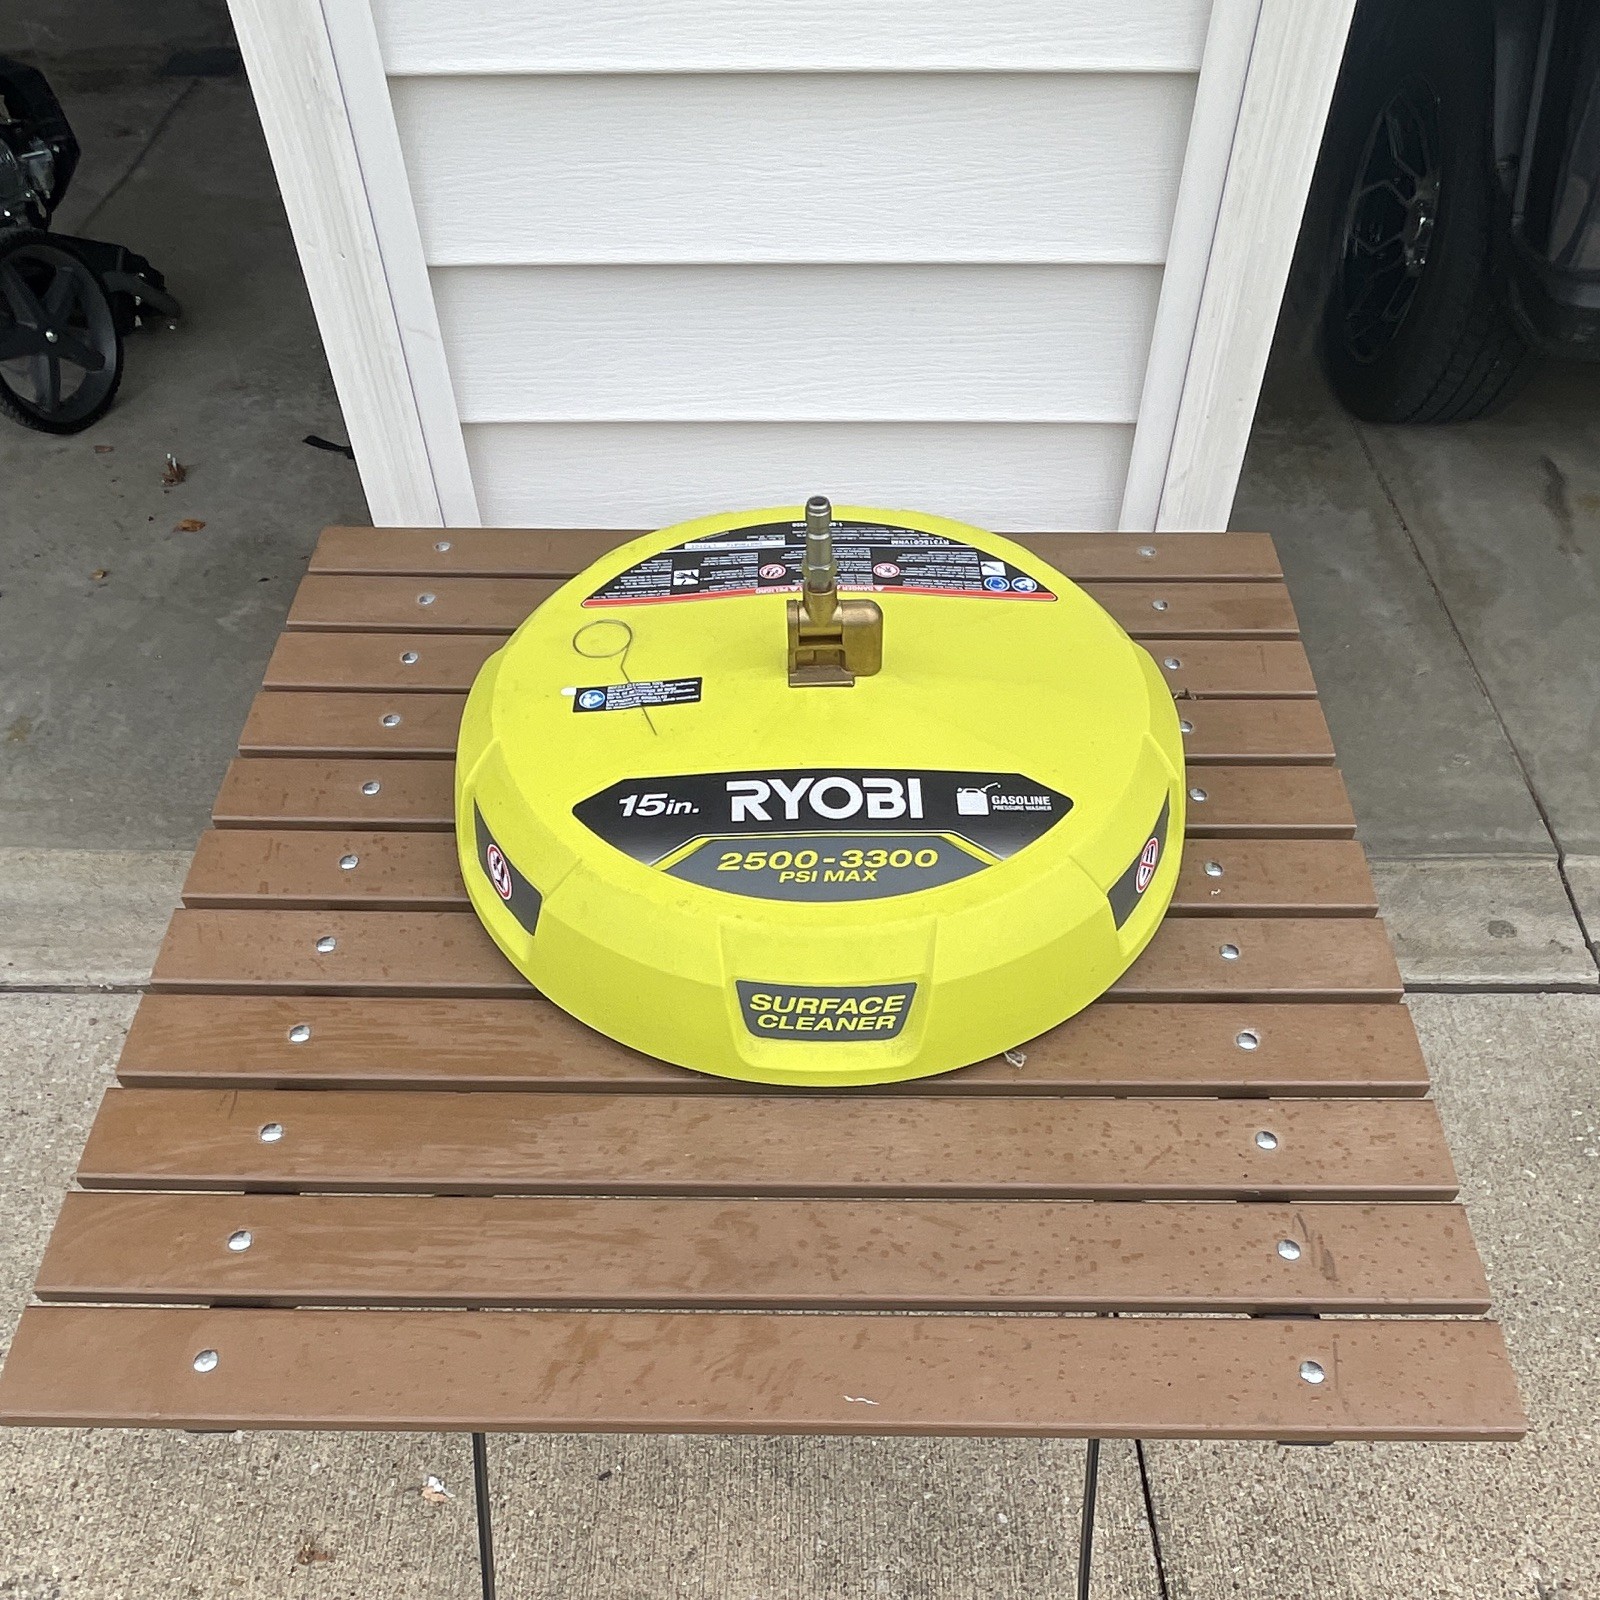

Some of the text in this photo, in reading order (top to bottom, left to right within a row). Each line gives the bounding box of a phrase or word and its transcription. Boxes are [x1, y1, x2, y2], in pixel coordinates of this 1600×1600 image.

[619, 793, 699, 817] 15in.
[726, 777, 923, 822] RYOBI
[991, 795, 1051, 806] GASOLINE
[779, 869, 877, 883] PSI MAX
[749, 994, 906, 1014] SURFACE
[757, 1014, 896, 1031] CLEANER
